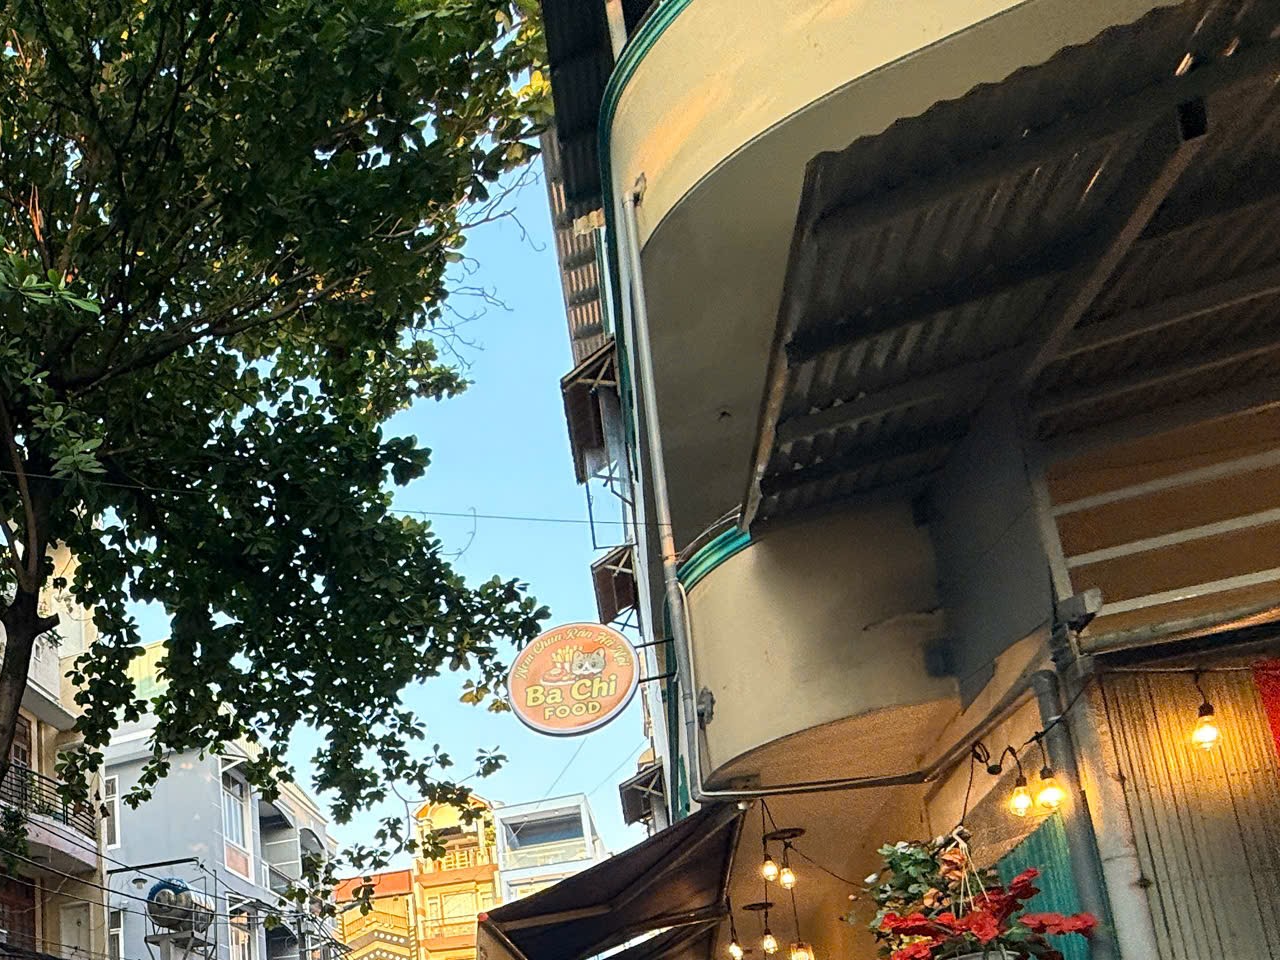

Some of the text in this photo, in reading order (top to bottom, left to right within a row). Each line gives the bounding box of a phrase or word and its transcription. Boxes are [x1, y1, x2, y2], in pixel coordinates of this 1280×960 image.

[525, 674, 617, 706] Ba Chi
[544, 702, 601, 720] FOOD
